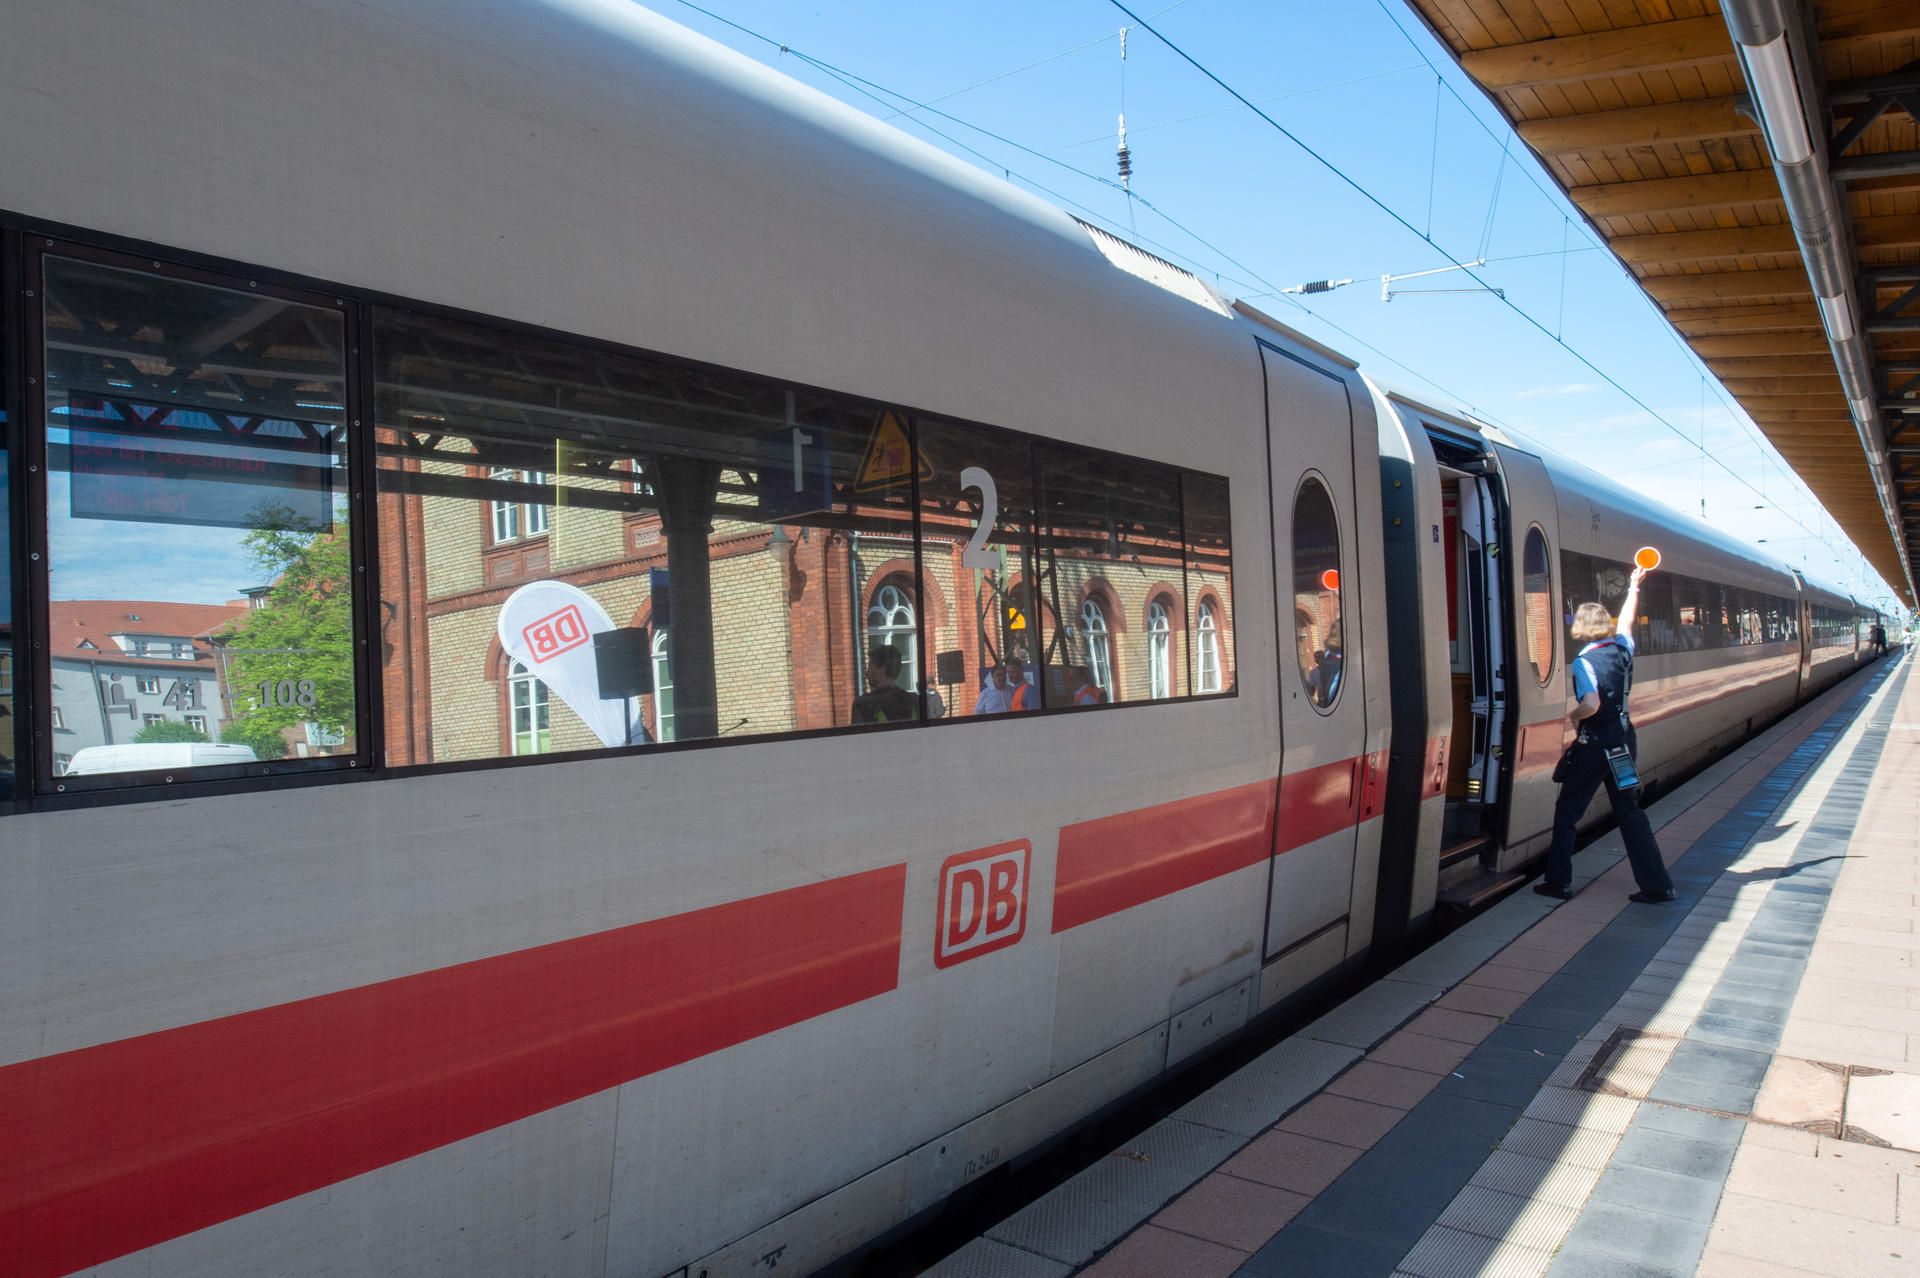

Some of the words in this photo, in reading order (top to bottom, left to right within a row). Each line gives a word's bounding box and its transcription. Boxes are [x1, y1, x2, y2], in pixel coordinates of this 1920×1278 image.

[960, 466, 1001, 568] 2
[162, 677, 207, 711] 41
[257, 679, 317, 709] 108
[947, 857, 1020, 949] DB
